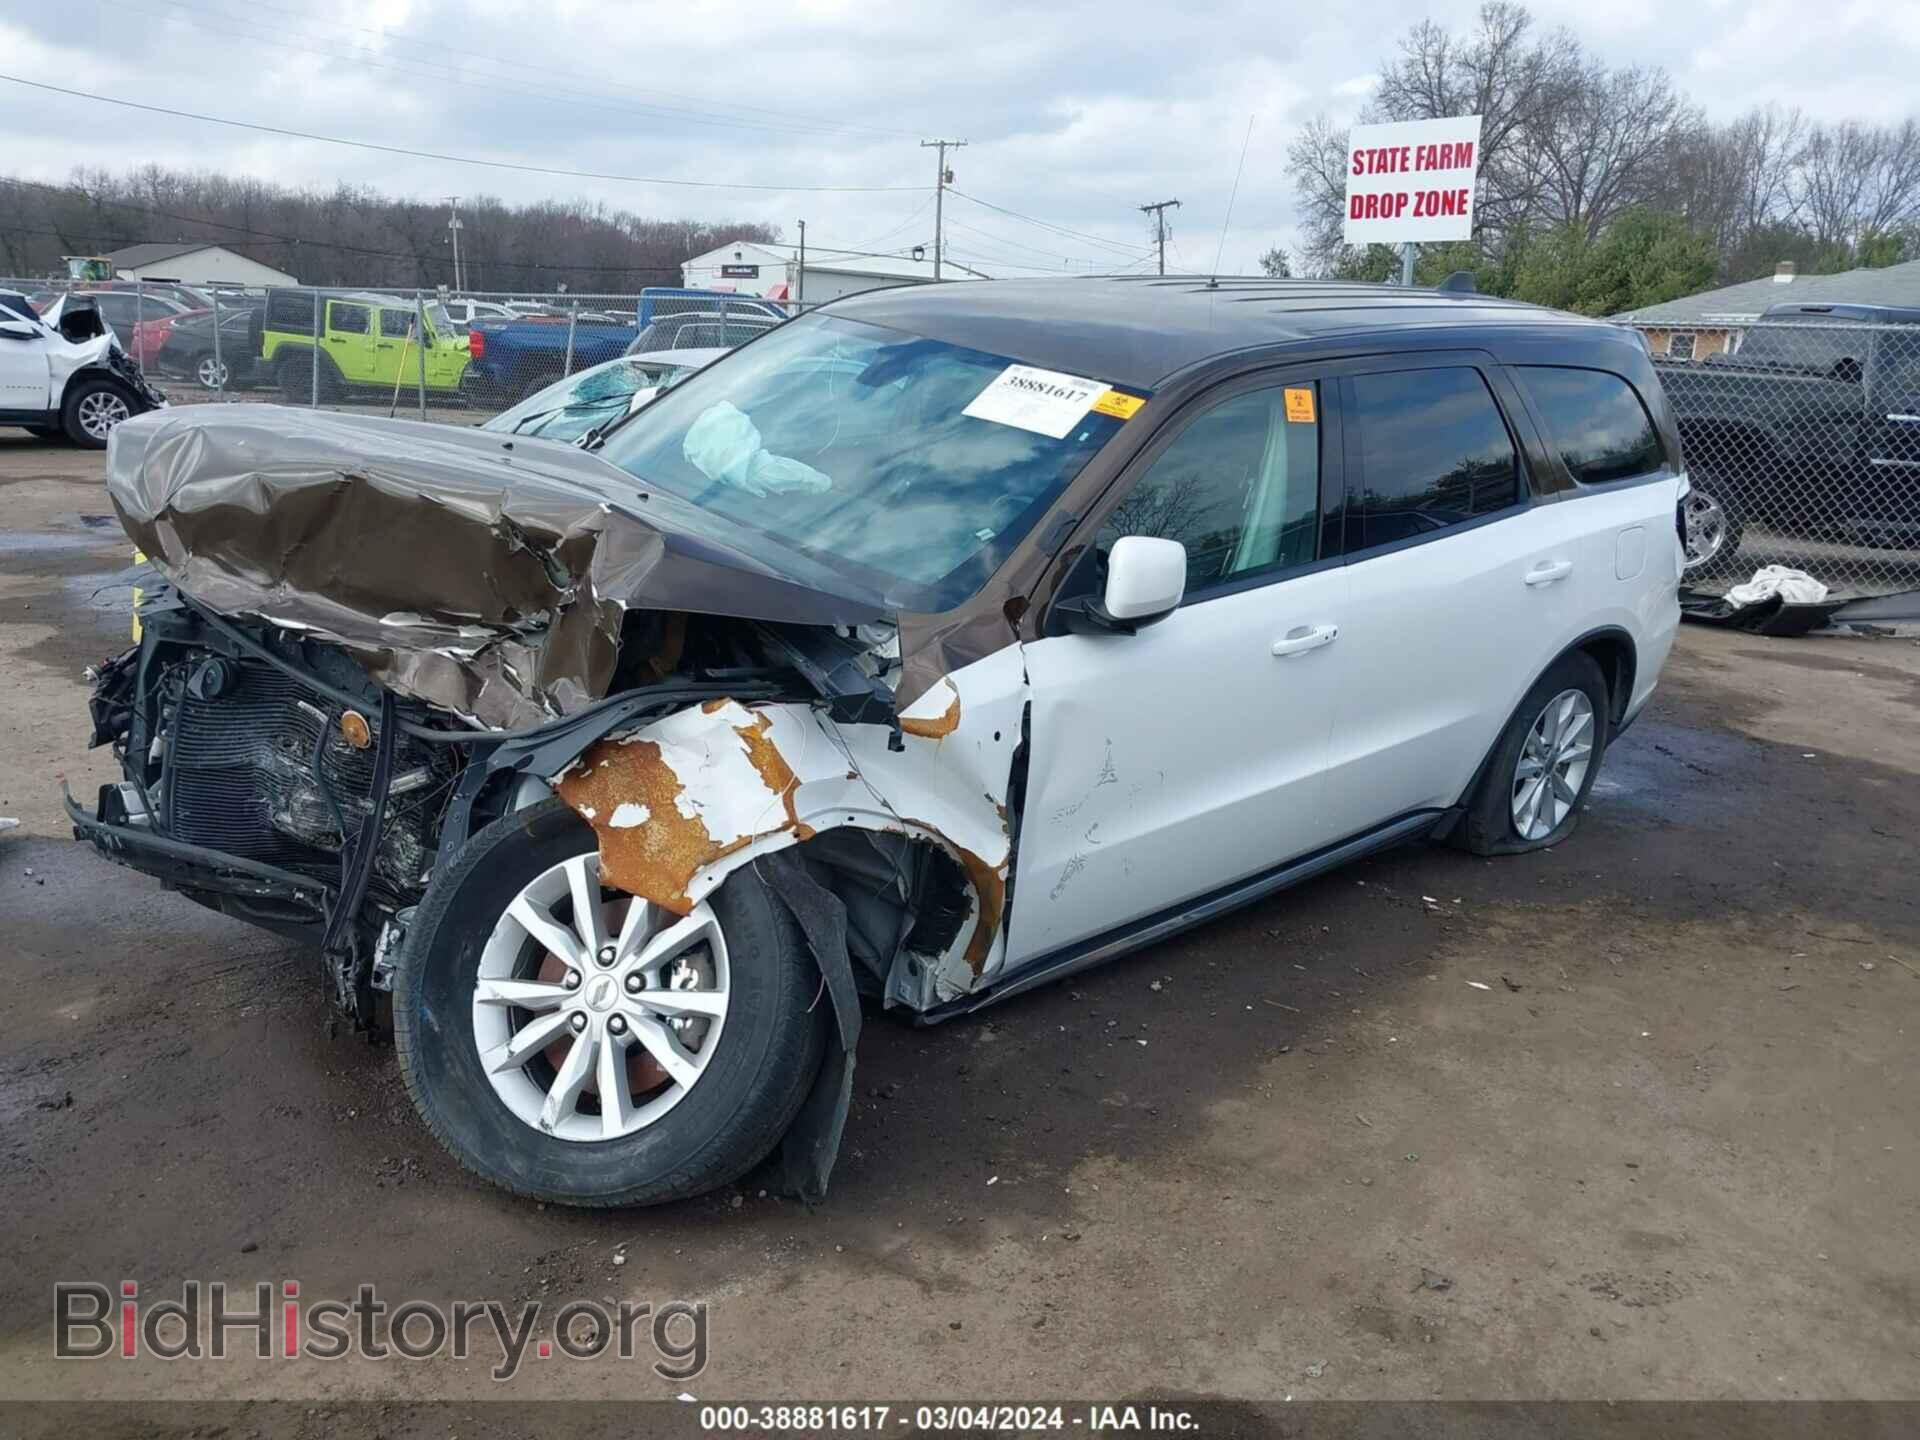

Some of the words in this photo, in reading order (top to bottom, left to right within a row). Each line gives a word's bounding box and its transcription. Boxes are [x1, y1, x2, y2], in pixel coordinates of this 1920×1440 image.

[1352, 146, 1411, 175] STATE
[1415, 141, 1474, 171] FARM
[1350, 192, 1409, 219] DROP
[1412, 189, 1469, 217] ZONE
[1005, 376, 1088, 402] 38881617
